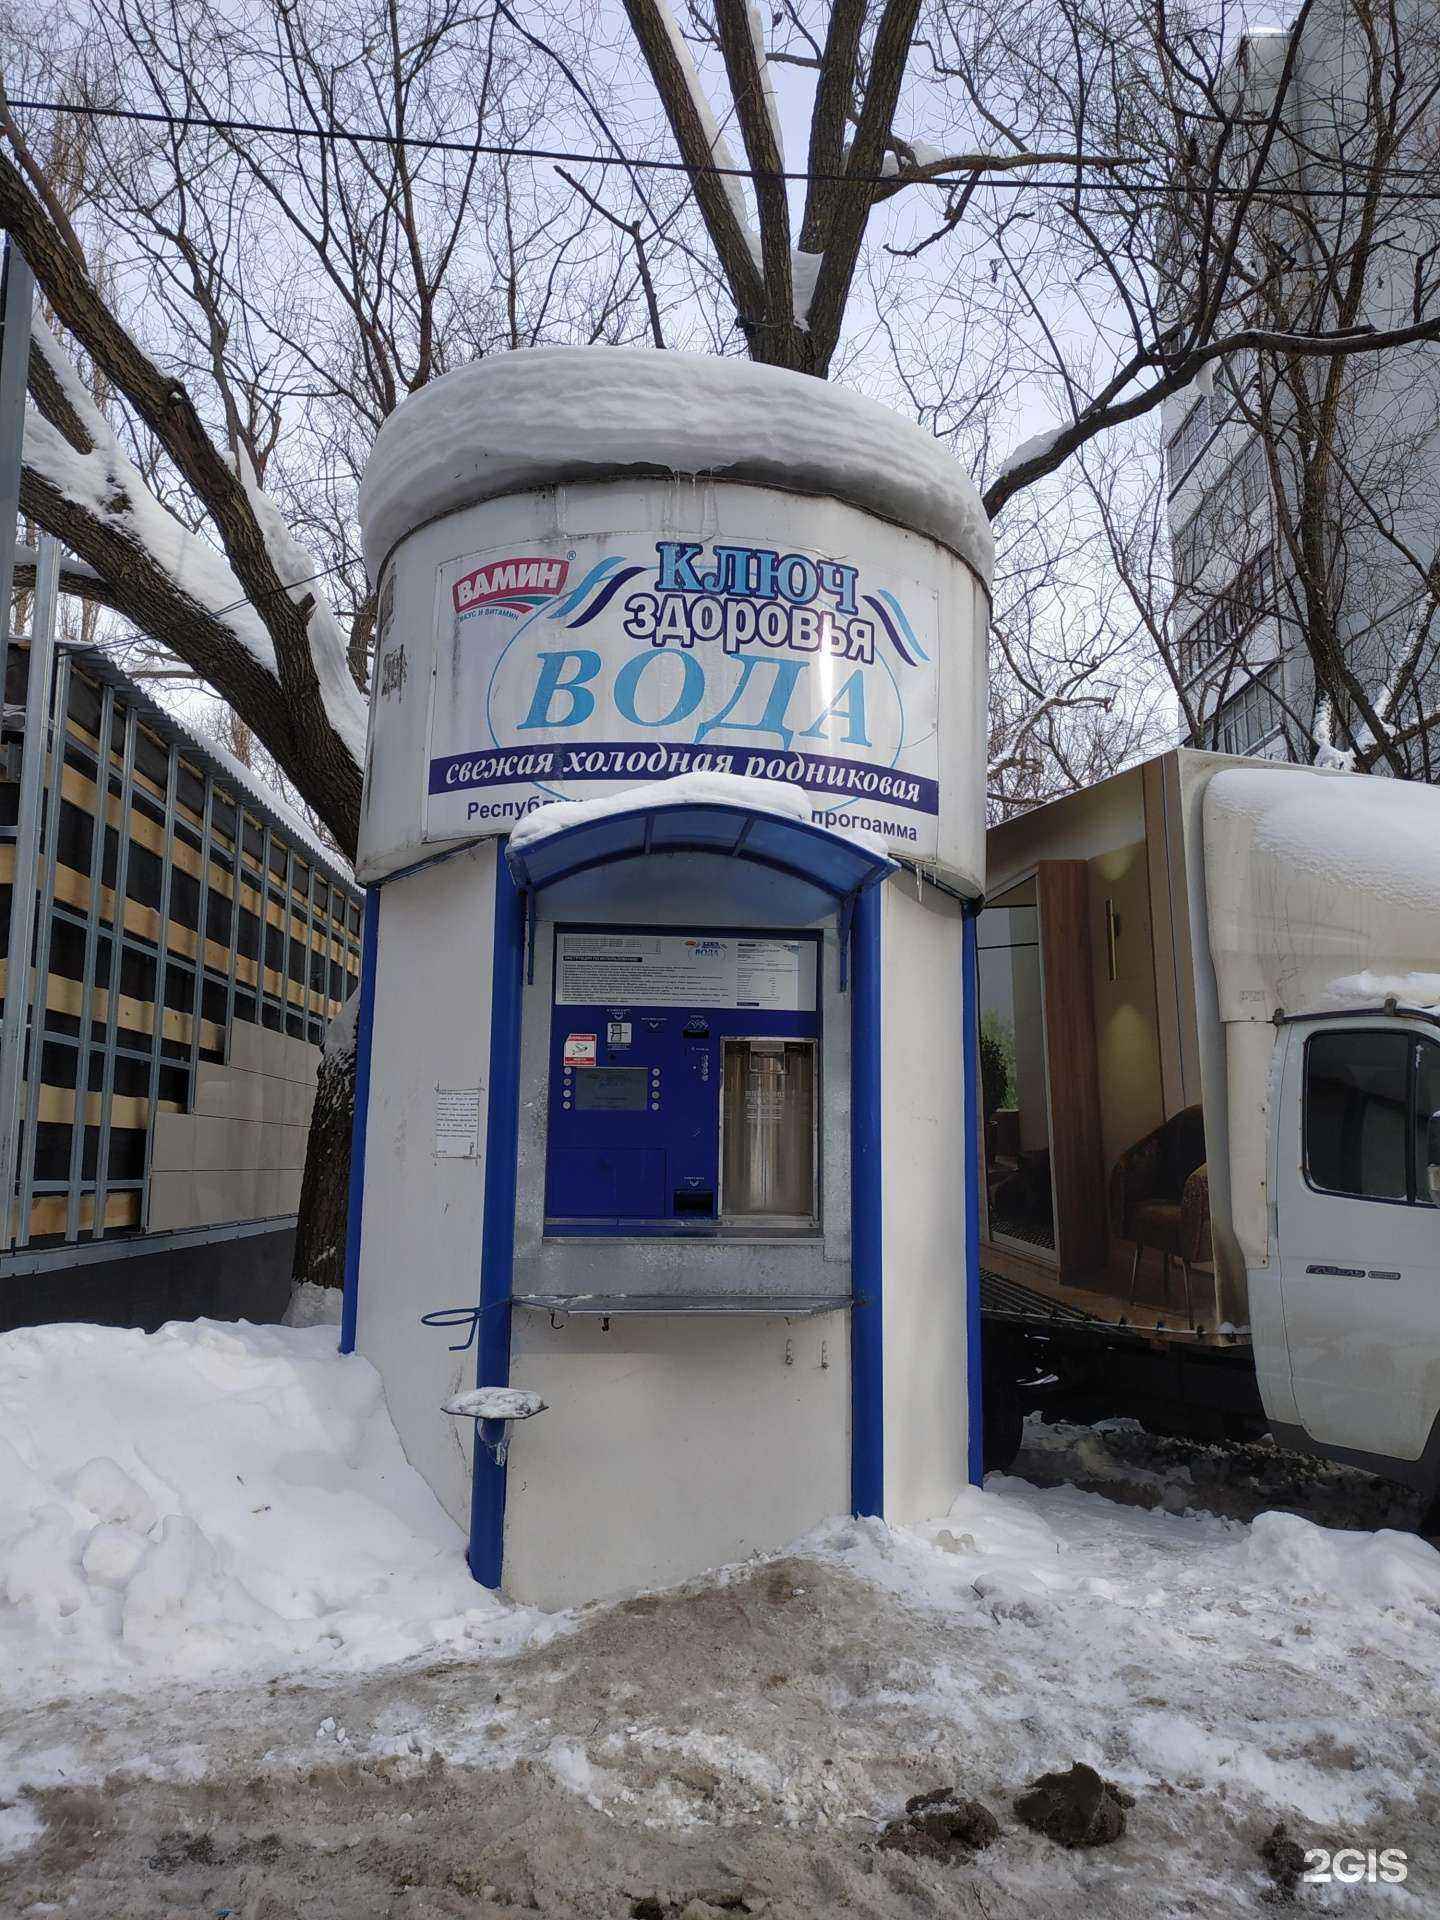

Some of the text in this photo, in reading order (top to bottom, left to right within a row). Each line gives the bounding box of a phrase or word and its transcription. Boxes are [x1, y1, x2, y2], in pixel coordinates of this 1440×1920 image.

[456, 561, 562, 606] ВАМИН
[655, 541, 859, 616] КЛЮЧ
[516, 647, 873, 752] ВОДА
[445, 742, 921, 803] свежая холодная родниковая
[811, 809, 918, 842] программа
